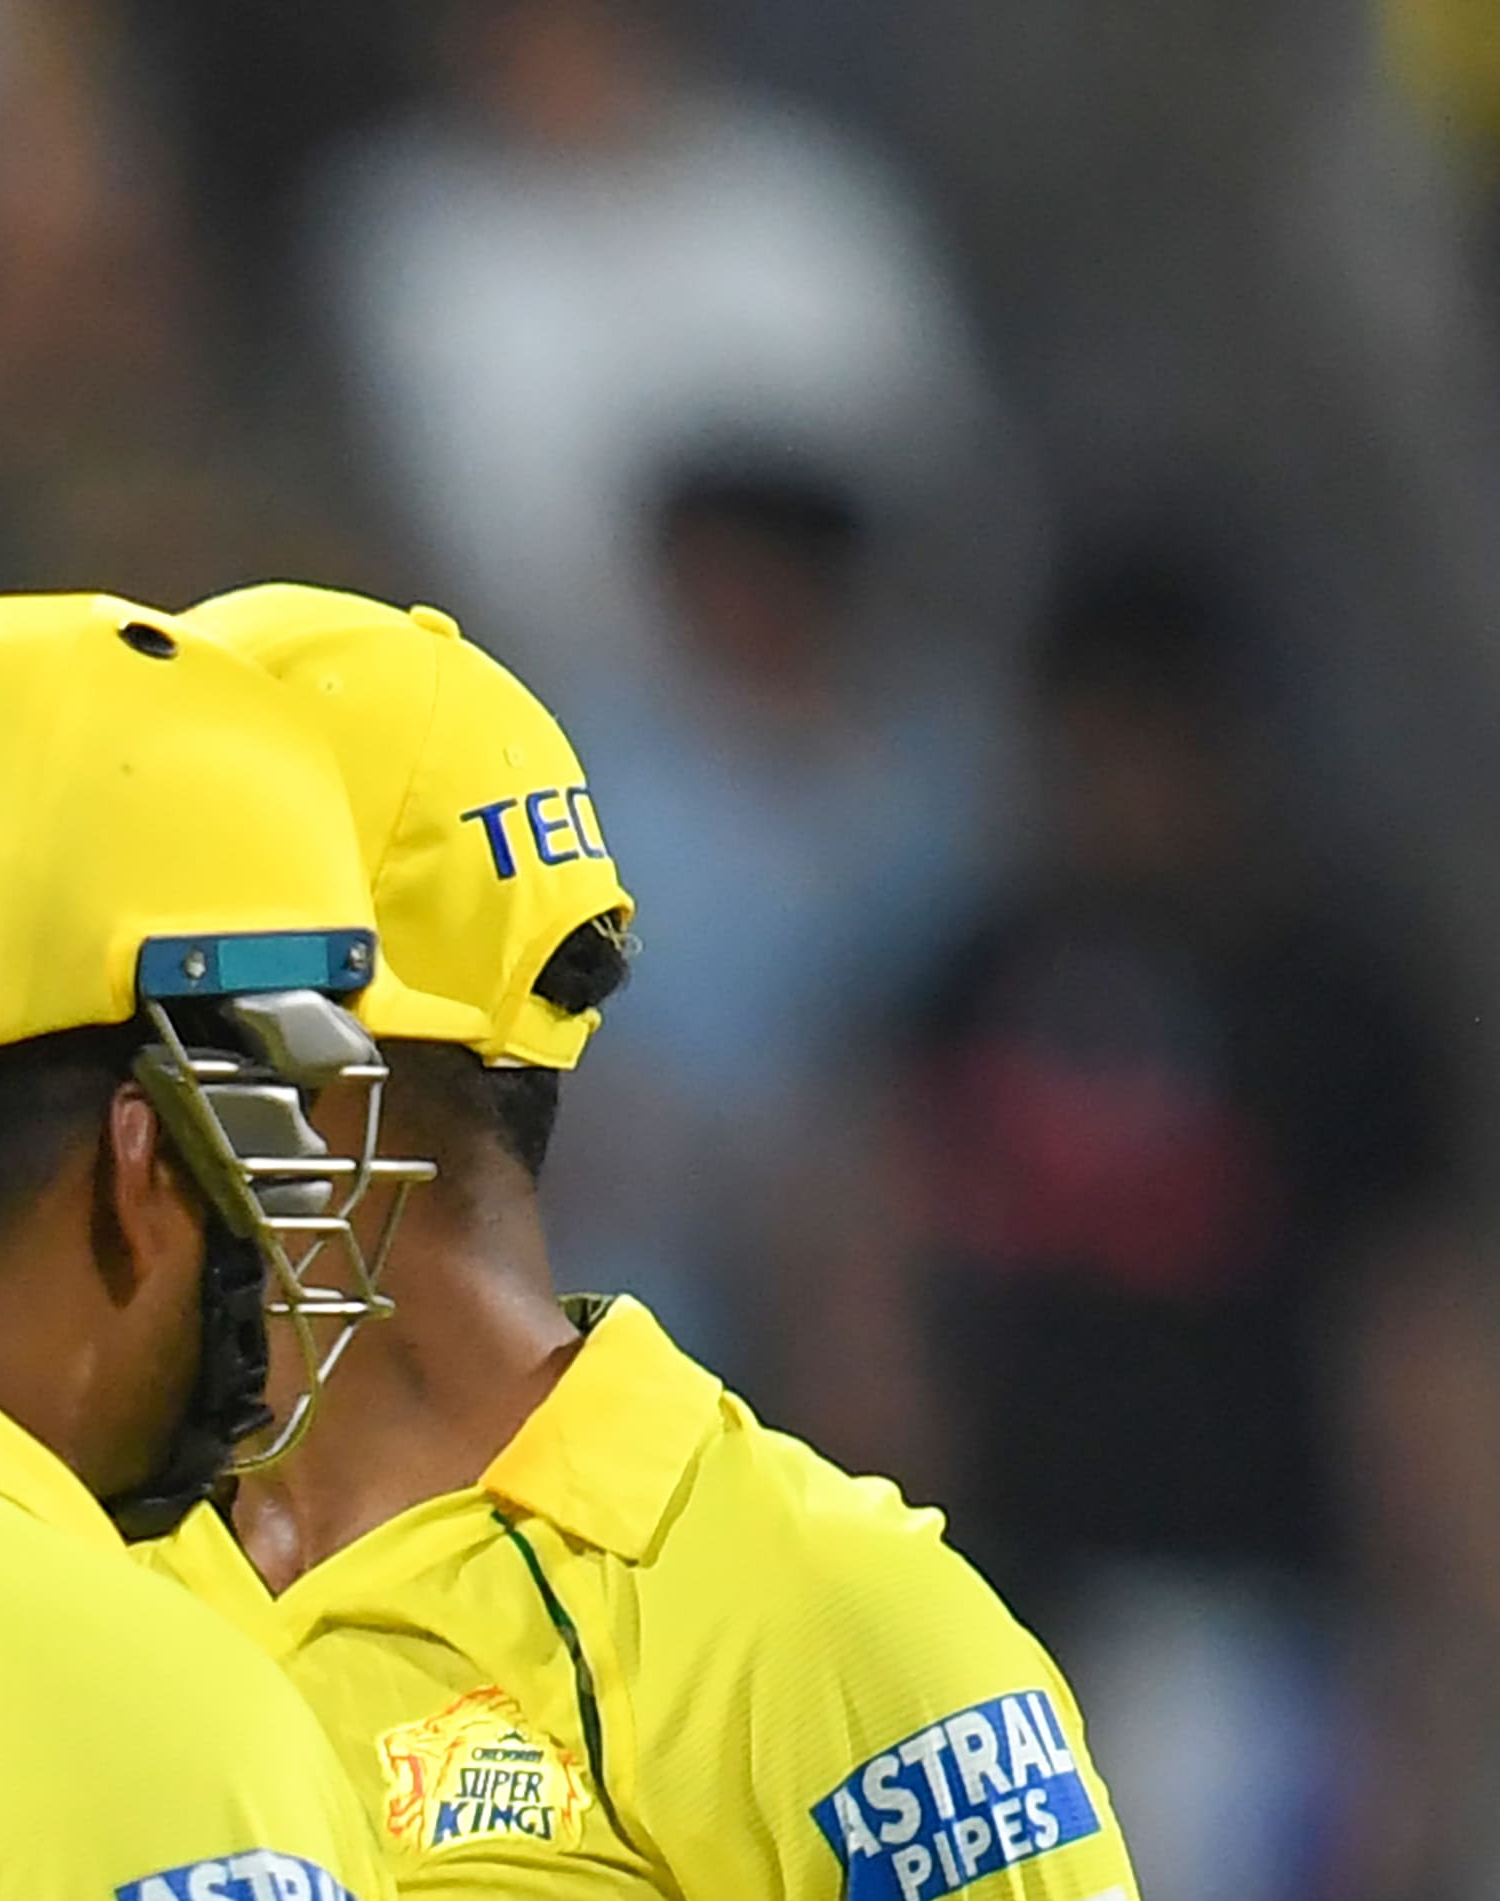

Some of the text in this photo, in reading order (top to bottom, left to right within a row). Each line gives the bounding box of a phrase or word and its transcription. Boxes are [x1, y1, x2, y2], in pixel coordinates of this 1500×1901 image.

[454, 1767, 543, 1804] SUPER
[831, 1692, 1076, 1860] ASTRAL
[429, 1800, 555, 1848] KINGS
